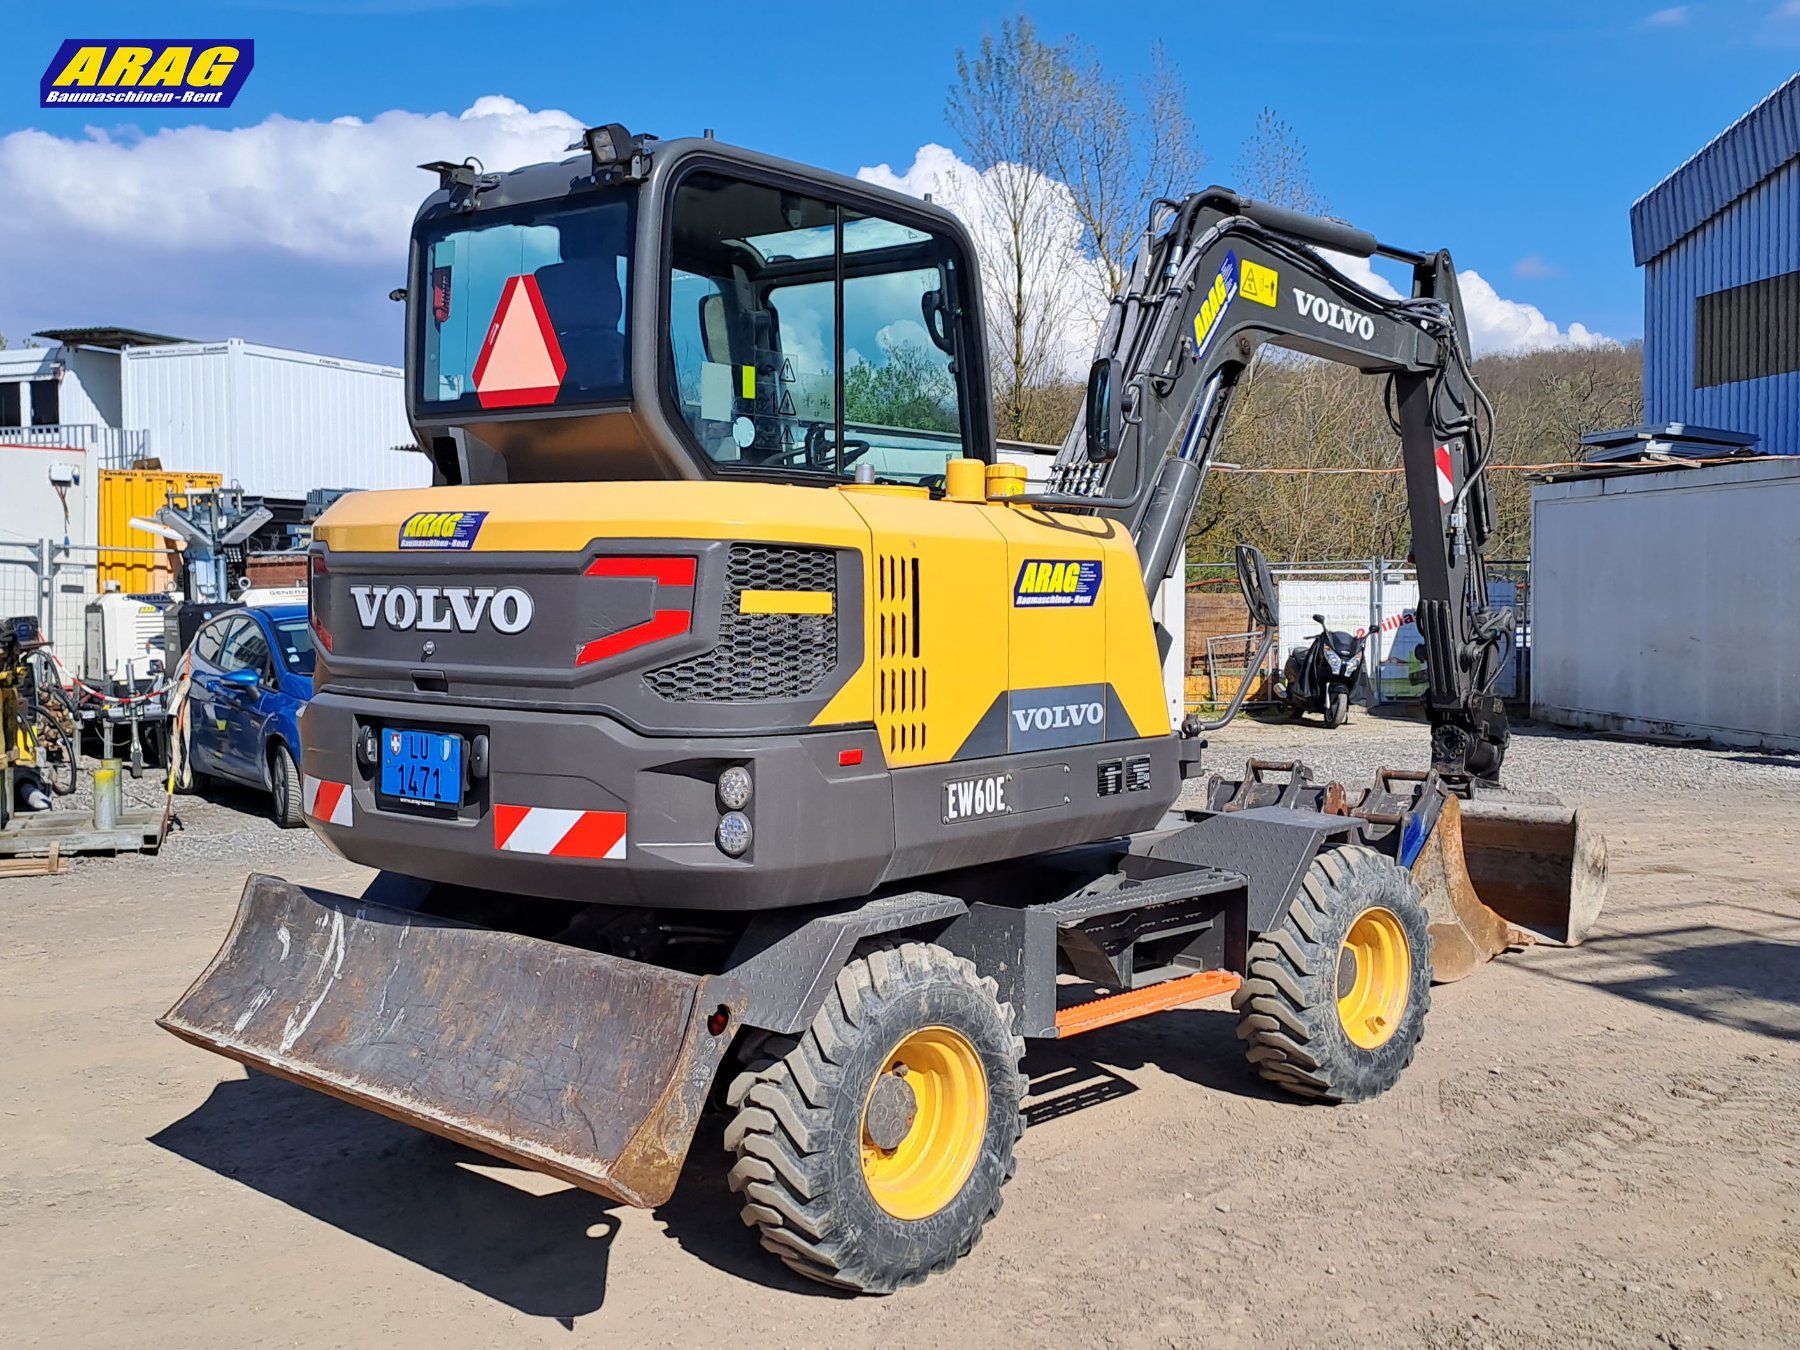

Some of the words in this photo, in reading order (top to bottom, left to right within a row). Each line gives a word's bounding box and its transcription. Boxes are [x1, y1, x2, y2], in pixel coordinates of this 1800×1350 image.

[1194, 273, 1227, 348] ARAG
[1292, 288, 1375, 341] VOLVO
[403, 512, 465, 538] ARAG
[1018, 562, 1081, 593] ARAG
[350, 585, 534, 635] VOLVO
[1012, 702, 1104, 732] VOLVO
[410, 735, 429, 759] LU
[398, 764, 441, 799] 1471
[948, 776, 1006, 819] EW60E
